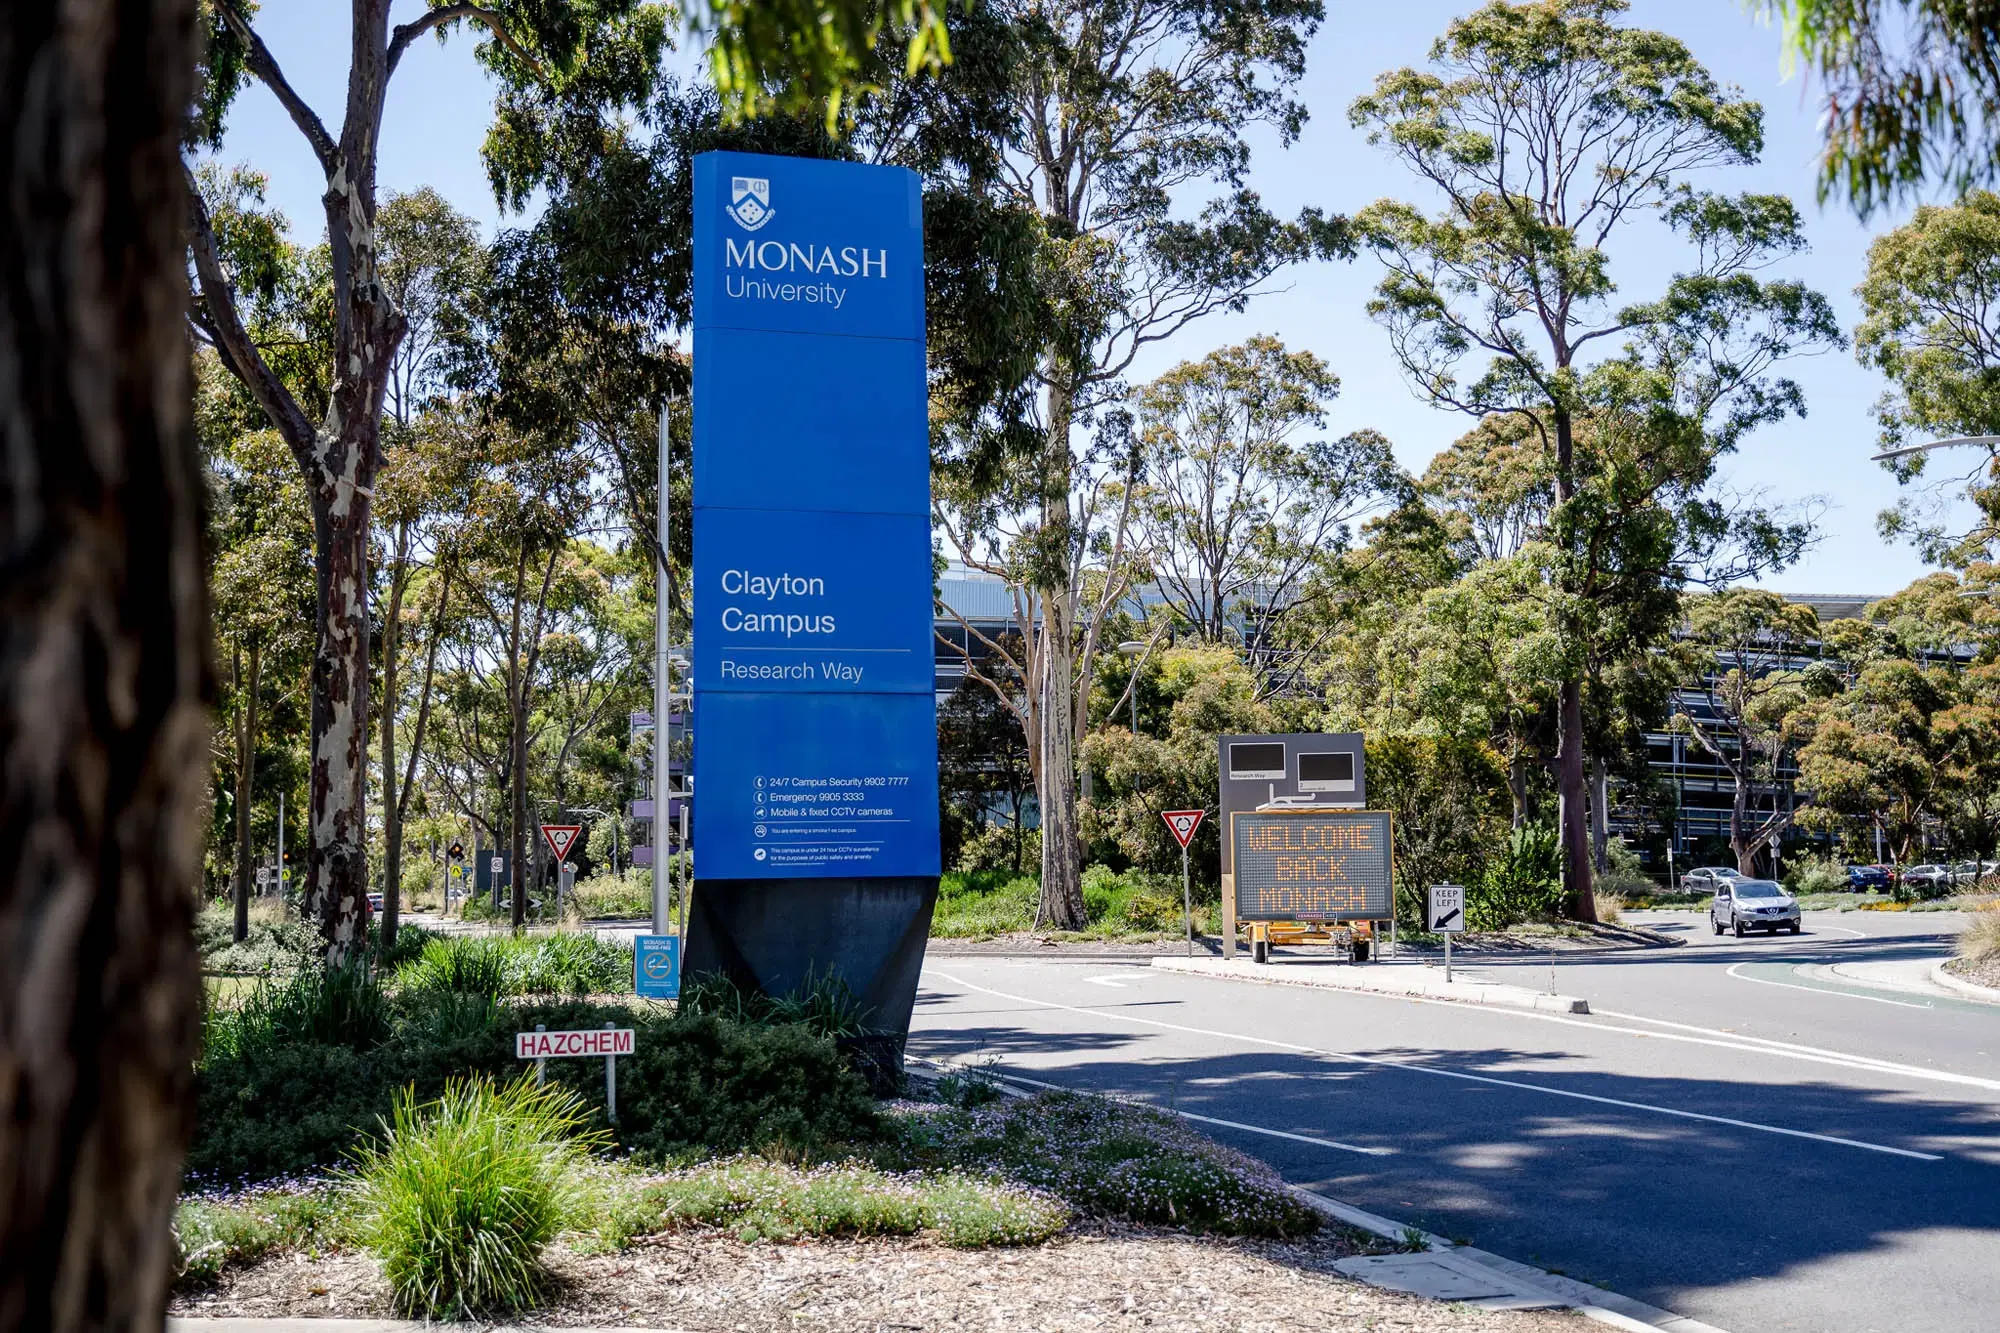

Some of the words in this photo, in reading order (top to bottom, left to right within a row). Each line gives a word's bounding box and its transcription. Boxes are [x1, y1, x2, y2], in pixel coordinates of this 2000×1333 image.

[726, 237, 887, 278] MONASH
[726, 274, 847, 309] University
[721, 569, 824, 600] Clayton
[721, 607, 836, 639] Campus
[721, 661, 815, 679] Research
[821, 662, 864, 684] Way
[770, 777, 790, 787] 24/7
[792, 777, 827, 788] Campus
[829, 777, 862, 788] Security
[864, 777, 886, 786] 9902
[888, 777, 909, 786] 7777
[770, 792, 817, 803] Emergency
[819, 792, 841, 801] 9905
[842, 792, 865, 801] 3333
[770, 807, 799, 817] Mobile
[800, 807, 808, 816] &
[809, 807, 829, 816] fixed
[830, 807, 856, 816] CCTV
[857, 808, 894, 816] cameras
[1249, 825, 1372, 850] WELCOME
[1276, 855, 1348, 881] BACK
[1259, 886, 1367, 912] MONASH
[1436, 890, 1458, 898] KEEP
[1437, 899, 1457, 907] LEFT
[521, 1031, 631, 1057] HAZCHEM
